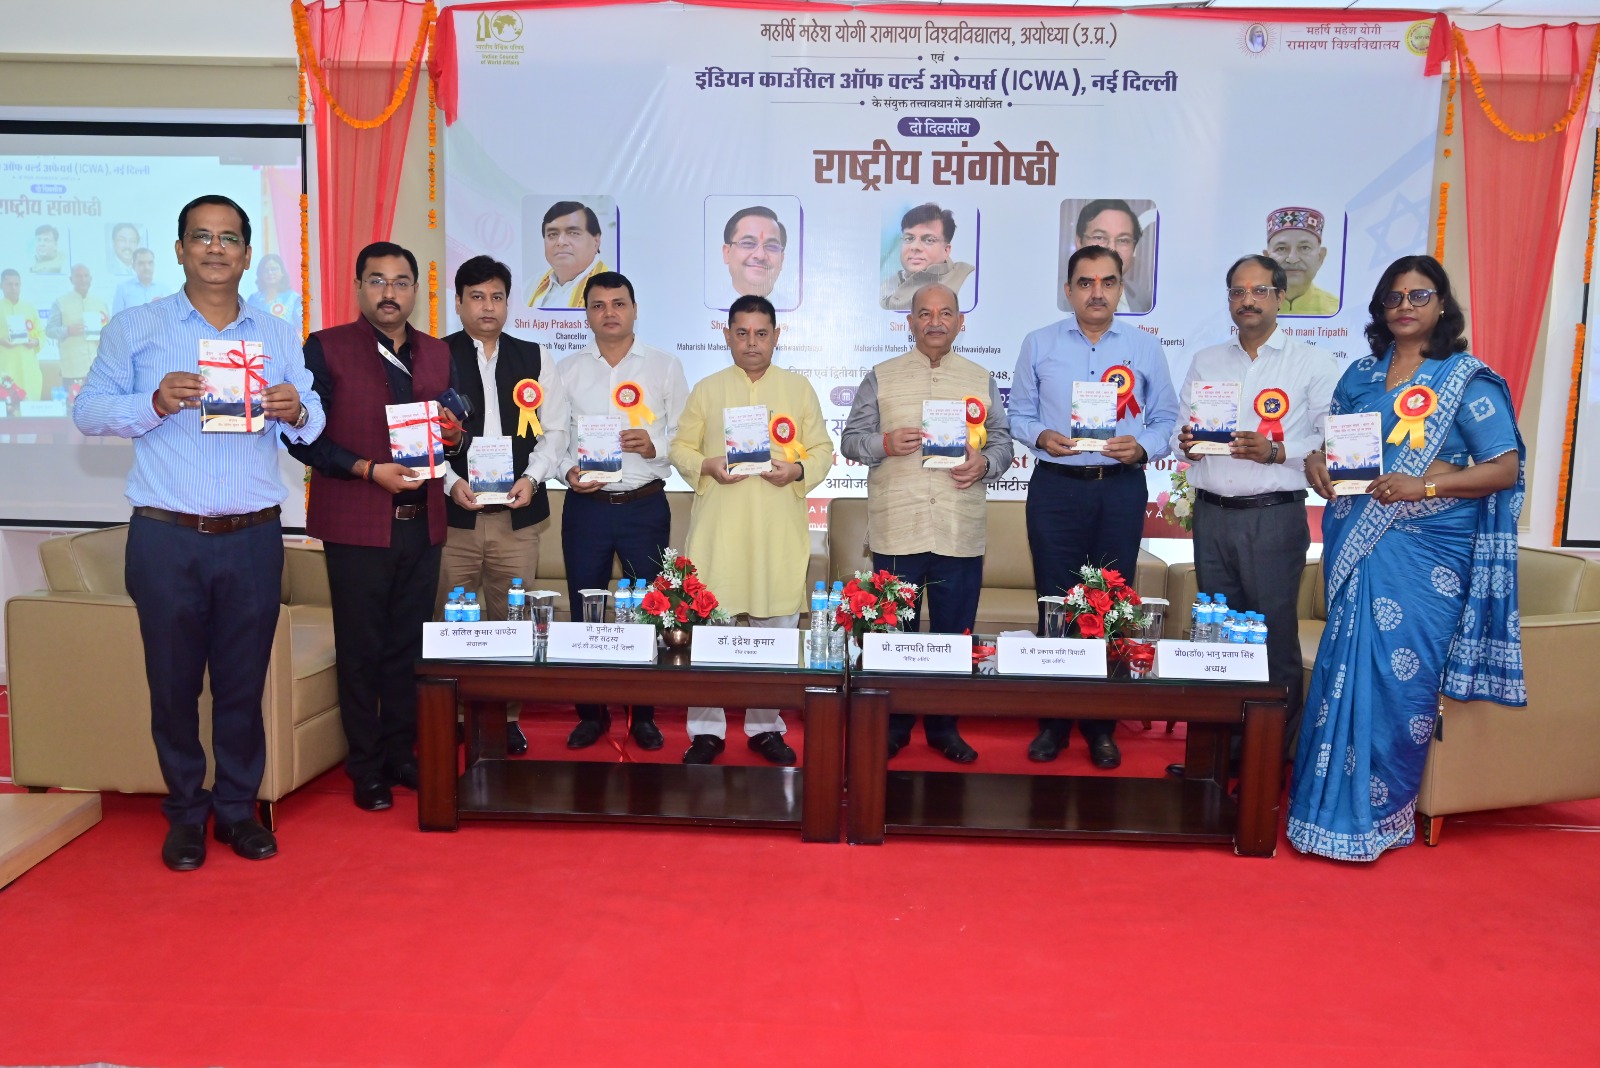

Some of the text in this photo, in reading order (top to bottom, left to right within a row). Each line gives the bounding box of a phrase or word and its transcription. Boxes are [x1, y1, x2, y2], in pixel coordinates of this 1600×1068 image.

[761, 18, 1118, 48] महर्षि महेश योगी रामायण विश्वविद्यालय, अयोध्या (उ.प्र.)
[1306, 23, 1381, 35] महर्षि महेश योगी
[1286, 37, 1400, 50] रामायण विश्वविद्यालय
[930, 51, 945, 63] एवं
[695, 66, 1178, 96] इंडियन काउंसिल ऑफ वर्ल्ड अफेयर्स (ICWA), नई दिल्ली
[872, 96, 881, 107] के
[883, 97, 908, 111] संयुक्त
[954, 97, 962, 108] में
[964, 97, 1003, 109] आयोजित
[909, 118, 971, 135] दो दिवसीय
[813, 138, 1059, 191] राष्ट्रीय संगोष्ठी
[514, 319, 530, 329] Shri
[533, 319, 549, 330] Ajay
[551, 319, 582, 329] Prakash
[890, 322, 906, 332] Shri
[556, 332, 587, 340] Chancellor
[1296, 327, 1315, 337] mani
[1317, 327, 1348, 338] Tripathi
[554, 342, 566, 351] Yogi
[676, 343, 706, 351] Maharishi
[1160, 338, 1185, 347] Experts)
[854, 344, 883, 352] Maharishi
[884, 344, 908, 352] Mahesh
[952, 346, 1001, 354] Vishwavidyalaya
[440, 628, 450, 637] डॉ.
[474, 630, 493, 638] कुमार
[718, 636, 730, 645] डॉ.
[754, 638, 776, 648] कुमार
[882, 642, 952, 653] प्रो. दानपति तिवारी
[1240, 650, 1255, 659] सिंह
[1204, 665, 1227, 673] अध्यक्ष
